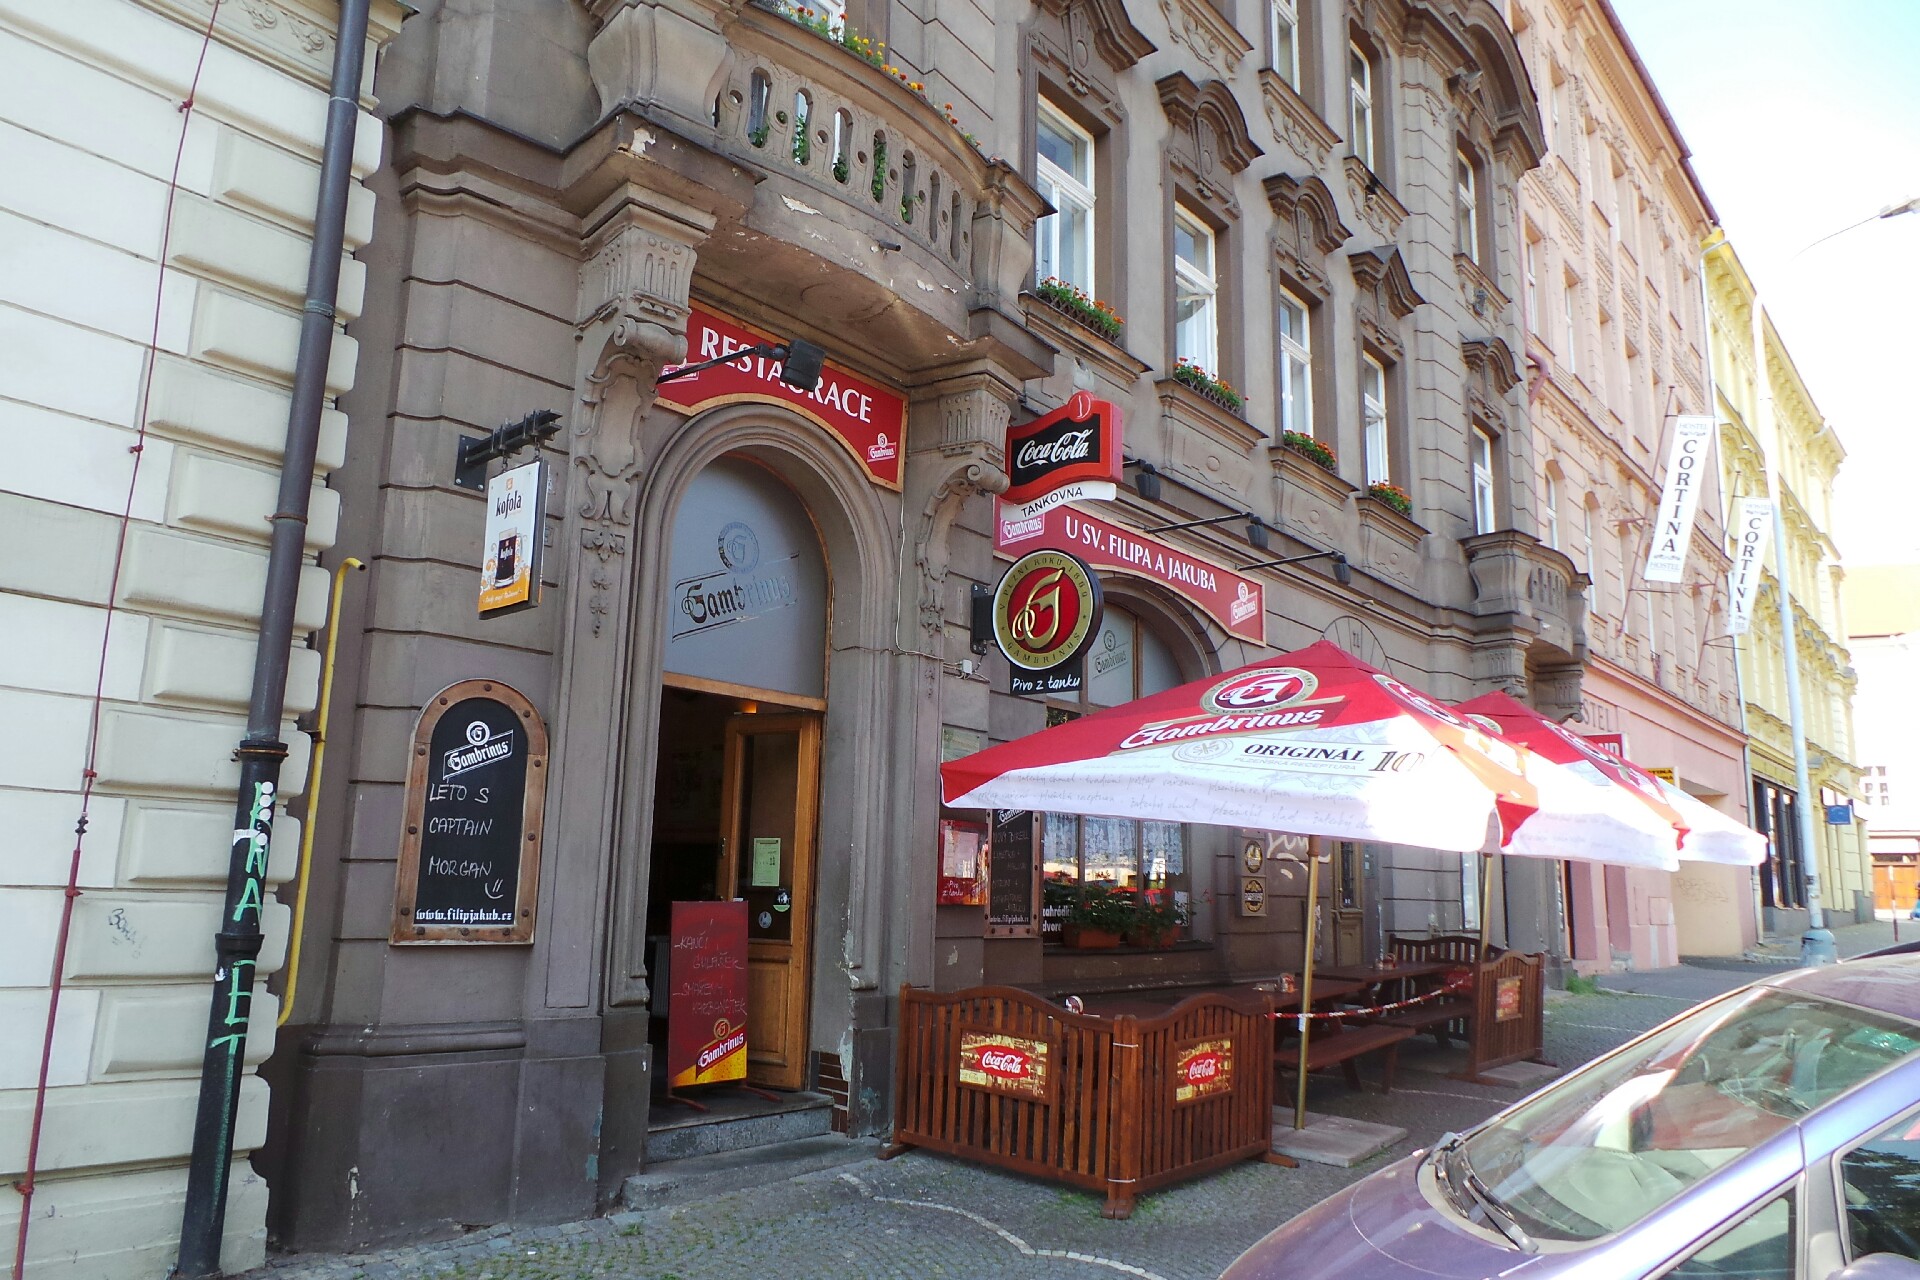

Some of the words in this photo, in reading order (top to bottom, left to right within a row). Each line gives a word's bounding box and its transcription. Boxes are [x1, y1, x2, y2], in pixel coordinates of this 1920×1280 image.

[701, 326, 873, 423] RESTARACE
[1016, 428, 1094, 469] Coca-Cola
[495, 490, 522, 519] kofola
[1020, 487, 1083, 517] TANKOVNA
[1662, 439, 1698, 552] CORTINA
[1065, 516, 1078, 538] U
[1082, 523, 1105, 551] SV.
[1109, 534, 1152, 569] FILIPA
[1155, 553, 1165, 573] A
[1167, 563, 1217, 592] JAKUBA
[1007, 632, 1080, 664] GAMBRINUS
[1012, 678, 1033, 691] Pivo
[1036, 680, 1044, 690] z
[1047, 674, 1081, 689] tanku
[1119, 709, 1325, 749] Gambrinus
[447, 740, 509, 771] Gambrinus
[1243, 742, 1366, 762] ORIGINÁL
[429, 817, 493, 836] CAPTAIN
[428, 856, 492, 878] MORGAN
[416, 907, 512, 923] www.filipjakub.cz
[698, 1032, 744, 1068] Gambrinus
[981, 1050, 1023, 1074] Coca-Cola
[1189, 1058, 1217, 1079] Coca-Cola
